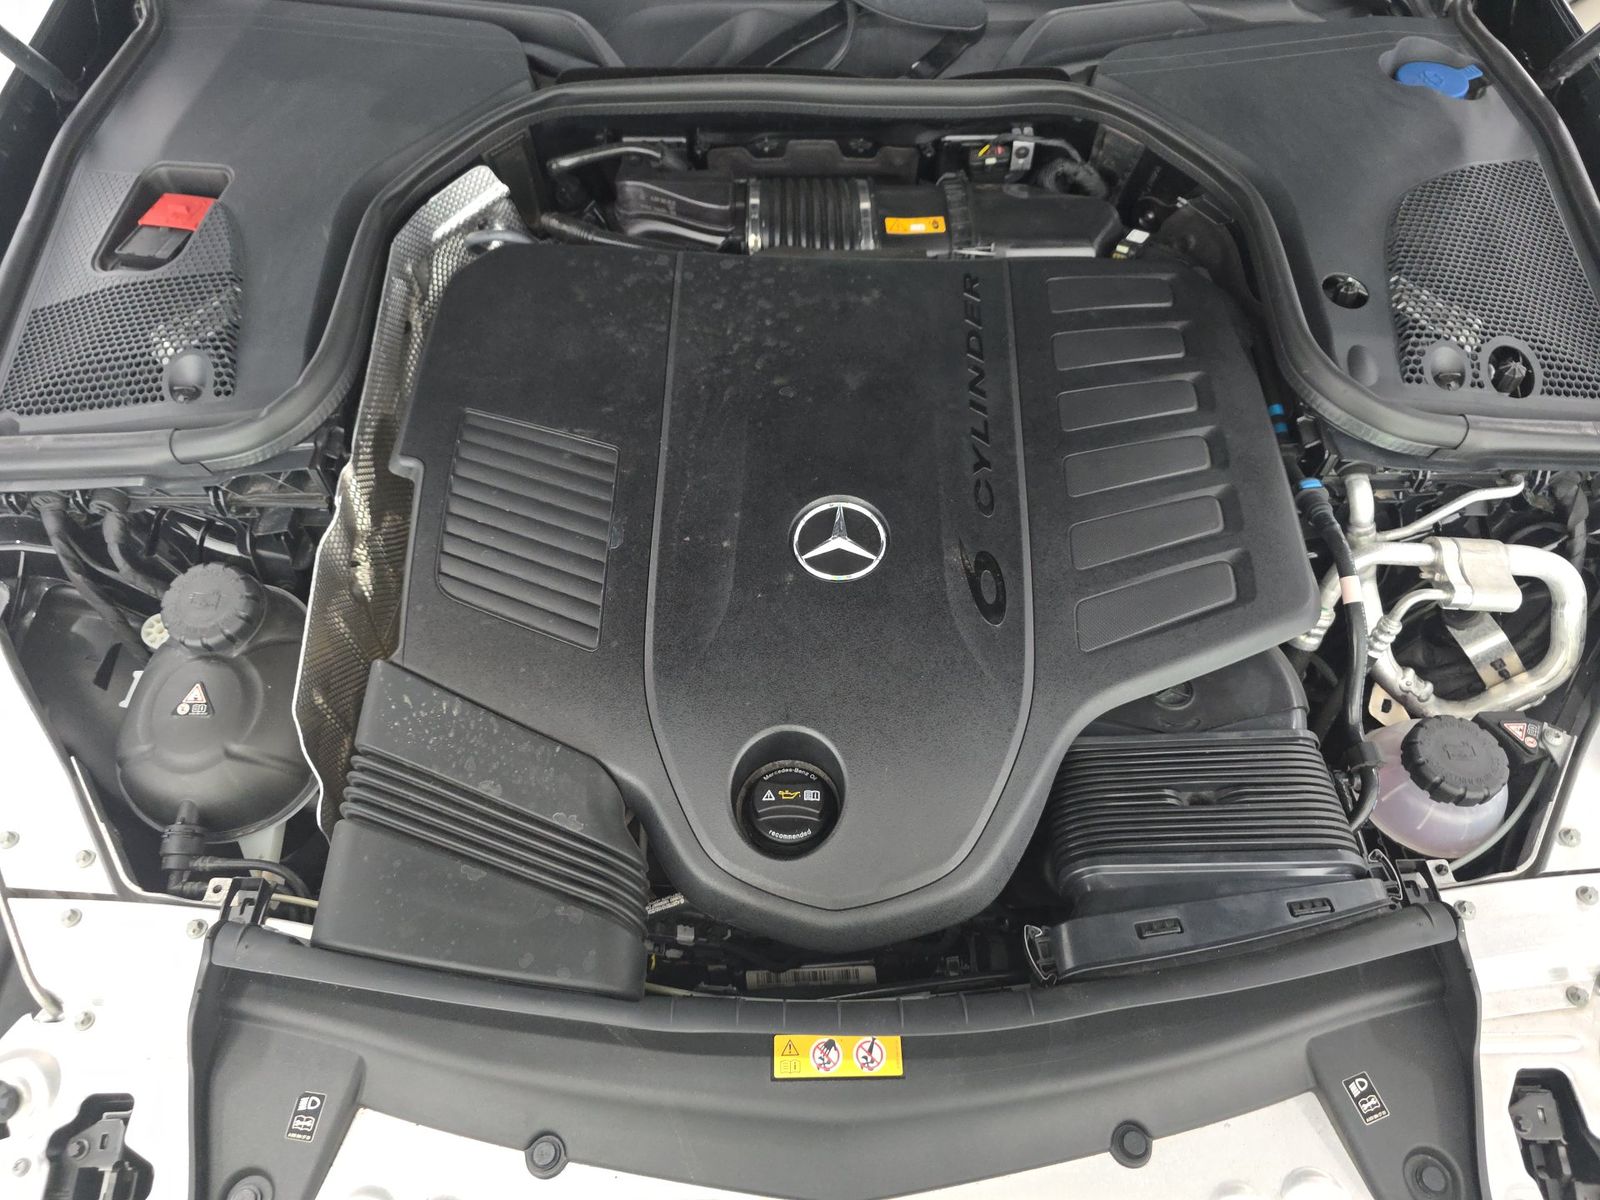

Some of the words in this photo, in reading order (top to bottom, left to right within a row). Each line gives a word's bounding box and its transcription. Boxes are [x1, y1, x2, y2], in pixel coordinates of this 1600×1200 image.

[963, 272, 995, 518] CYLINDER
[958, 536, 1007, 627] 6
[763, 768, 810, 781] Mercedes-Benz
[768, 828, 812, 840] recommended
